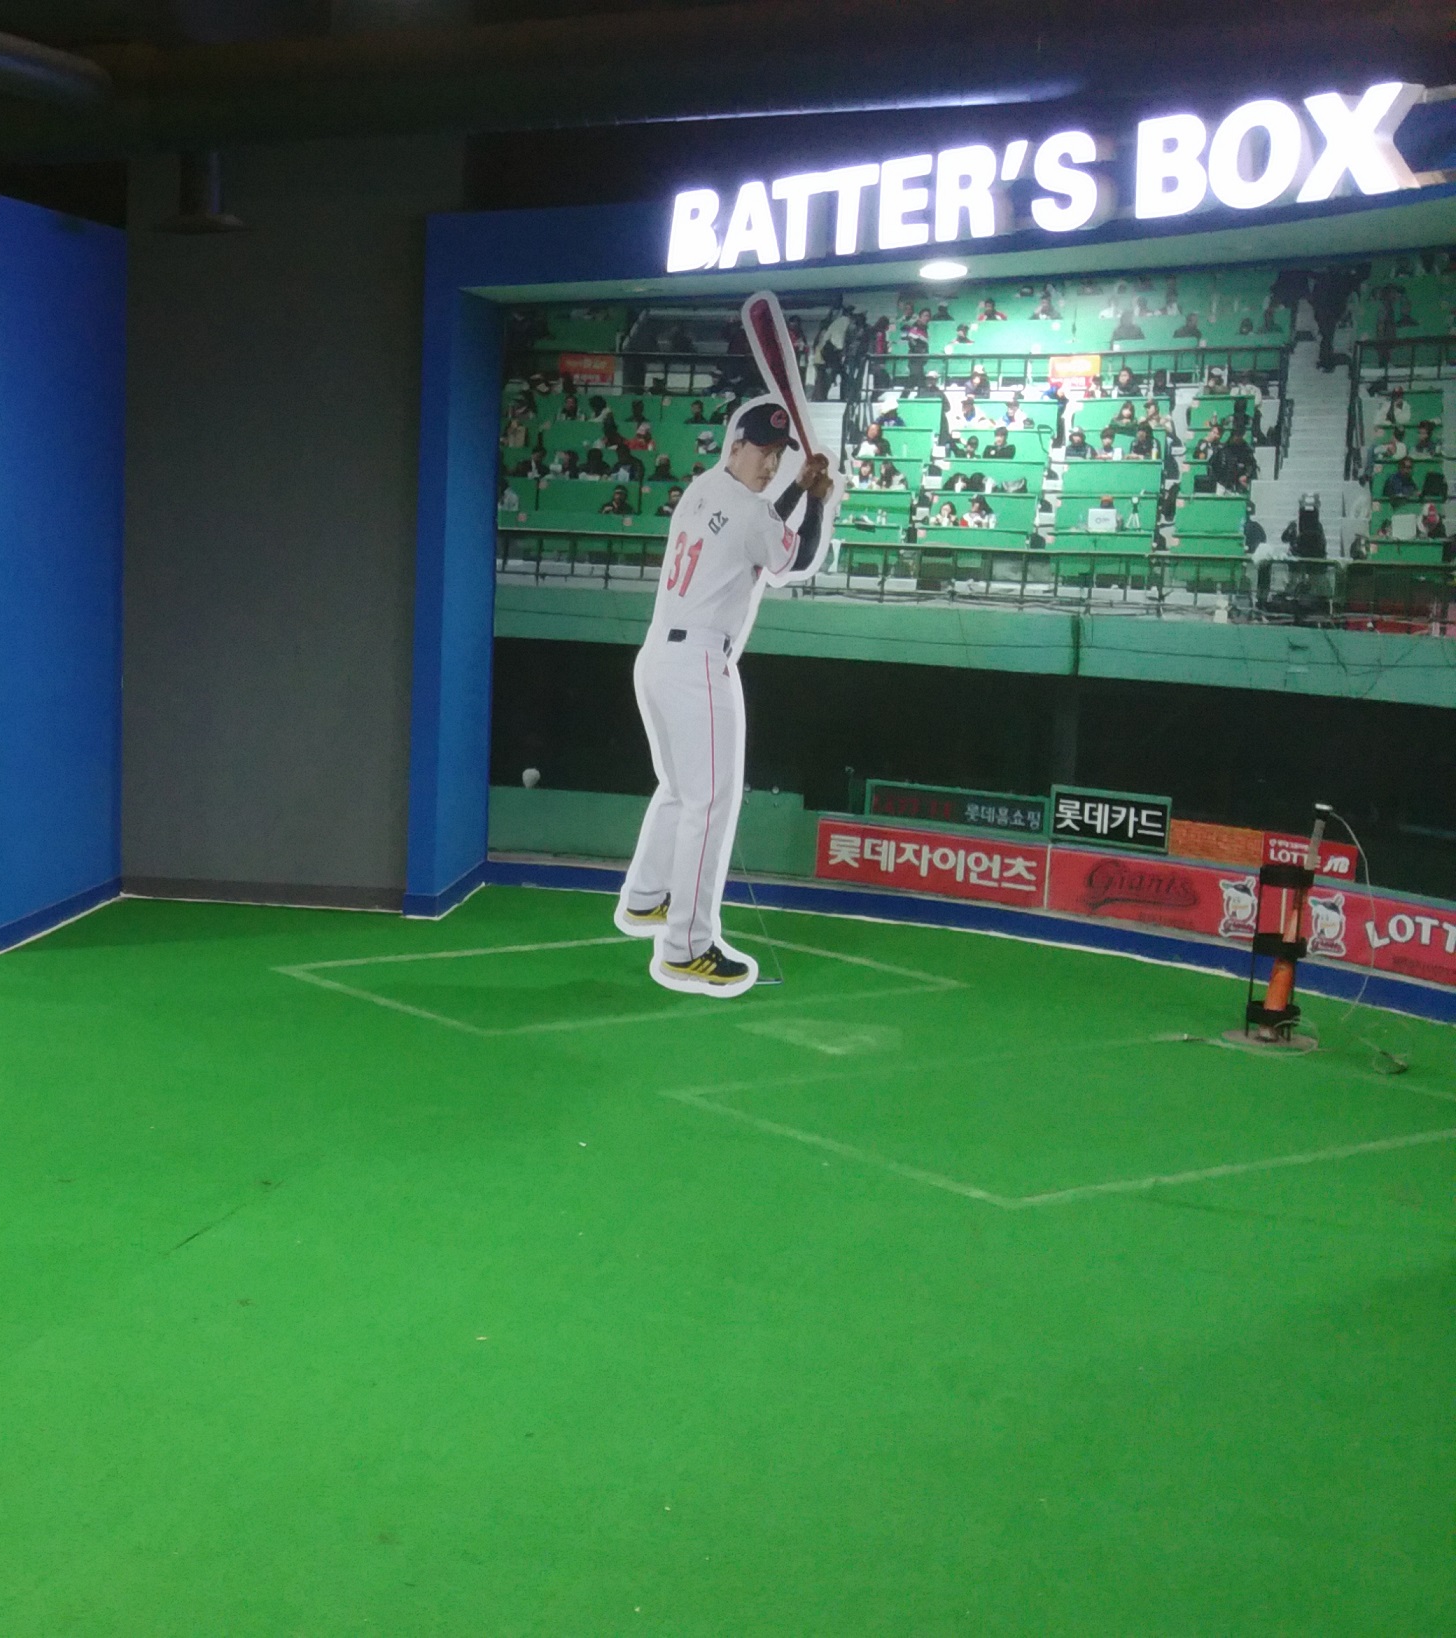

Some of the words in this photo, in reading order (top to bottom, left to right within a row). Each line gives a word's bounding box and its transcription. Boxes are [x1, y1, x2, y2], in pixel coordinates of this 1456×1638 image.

[666, 130, 1098, 273] BATTER'S
[1135, 81, 1422, 219] BOX
[667, 531, 704, 597] 31
[1055, 798, 1165, 838] 롯데카드
[827, 833, 1037, 892] 롯데자이언츠
[1086, 858, 1195, 900] Giants
